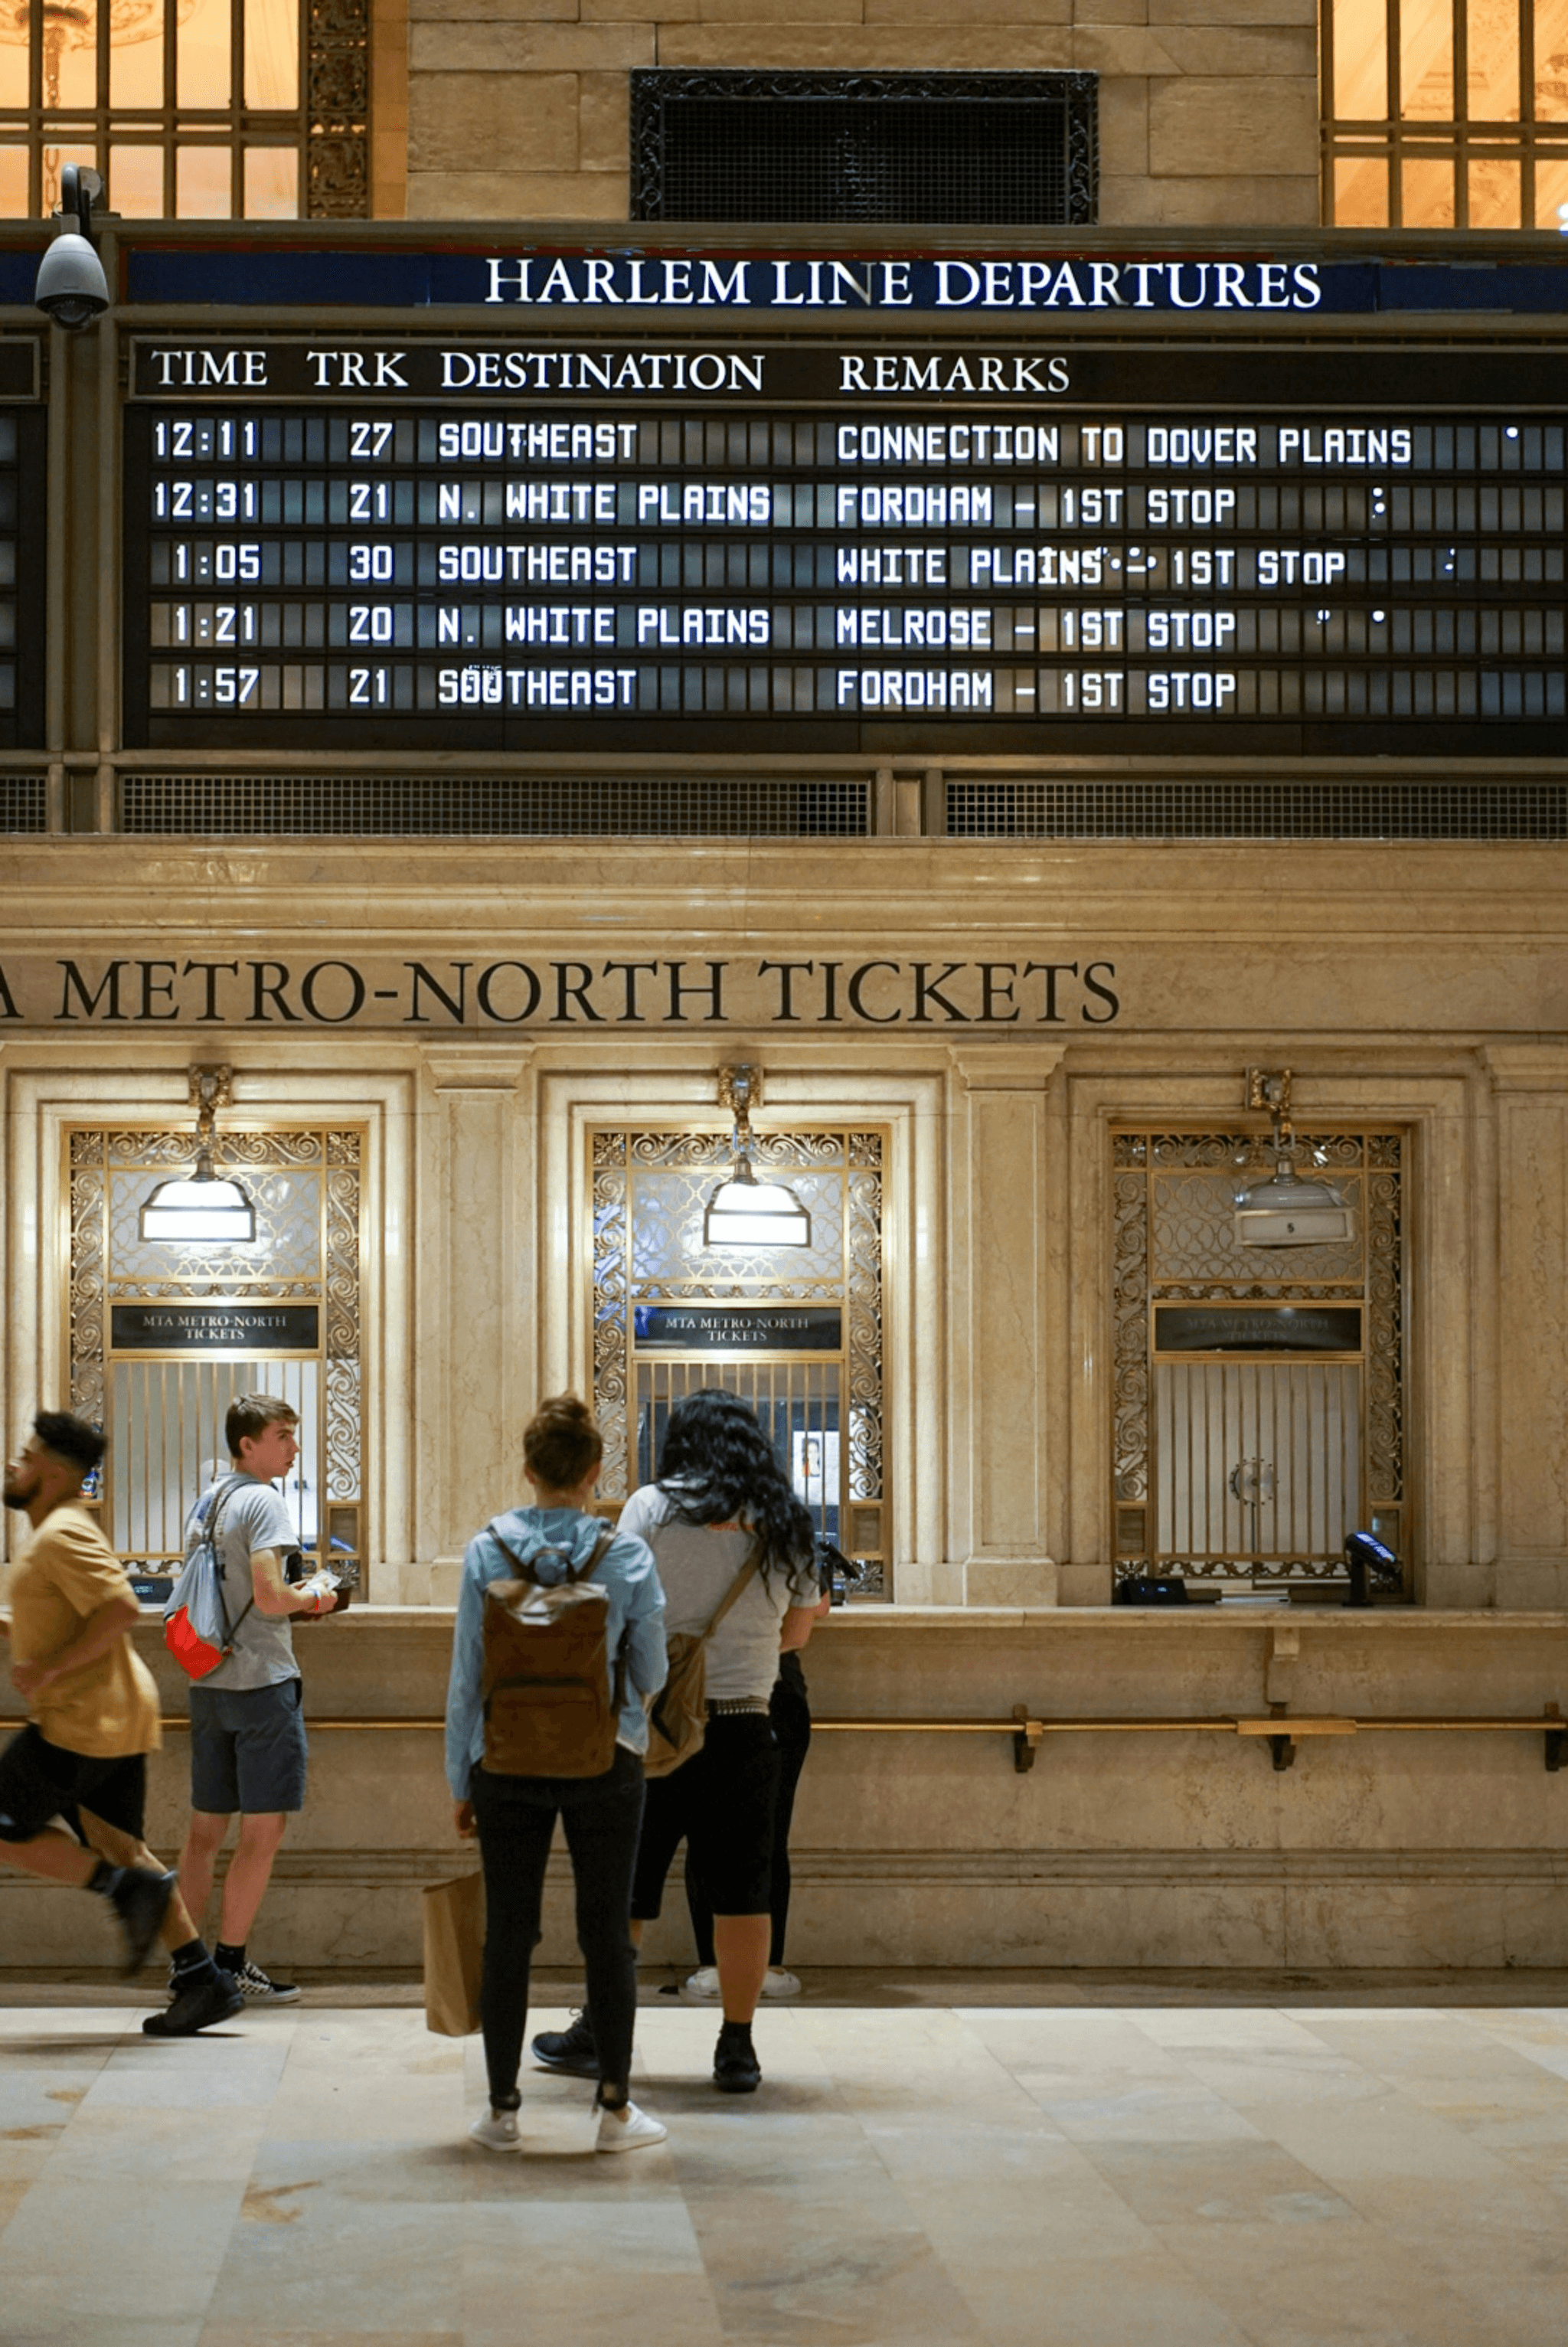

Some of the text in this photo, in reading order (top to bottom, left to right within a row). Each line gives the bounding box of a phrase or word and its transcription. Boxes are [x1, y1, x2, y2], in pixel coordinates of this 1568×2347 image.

[485, 257, 1322, 309] HARLEM LINE DEPARTURES
[152, 351, 1070, 392] TIME TRK DESTINATION REMARKS
[155, 420, 1411, 463] 12:11 27 SOUTHEAST CONNECTION TO DOVER PLAINS
[155, 482, 254, 518] 12:31
[350, 483, 387, 518] 21
[439, 484, 475, 519] N.
[505, 483, 616, 520] WHITE
[639, 485, 770, 521] PLAINS
[838, 485, 992, 523] FORDHAM
[1063, 488, 1124, 523] 1ST
[1148, 489, 1235, 524] STOP
[176, 544, 260, 580] 1:05
[349, 544, 393, 580] 30
[439, 545, 637, 581] SOUTHEAST
[837, 548, 946, 583] WHITE
[971, 548, 1102, 585] PLAINS
[1173, 550, 1235, 585] 1ST
[1258, 550, 1345, 585] STOP
[176, 606, 253, 642] 1:21
[349, 606, 392, 641] 20
[438, 607, 475, 643] N.
[505, 606, 615, 643] WHITE
[638, 607, 769, 644] PLAINS
[837, 609, 991, 646] MELROSE
[1063, 610, 1124, 646] 1ST
[1148, 612, 1236, 647] STOP
[176, 668, 259, 703] 1:57
[349, 668, 386, 703] 21
[838, 669, 992, 707] FORDHAM
[1063, 672, 1124, 708] 1ST
[1148, 672, 1236, 708] STOP
[54, 959, 729, 1024] METRO-NORTH
[757, 959, 1120, 1023] TICKETS
[142, 1316, 287, 1327] MTA METRO-NORTH
[185, 1328, 245, 1340] TICKETS
[665, 1317, 809, 1329] MTA METRO-NORTH
[707, 1330, 767, 1341] TICKETS
